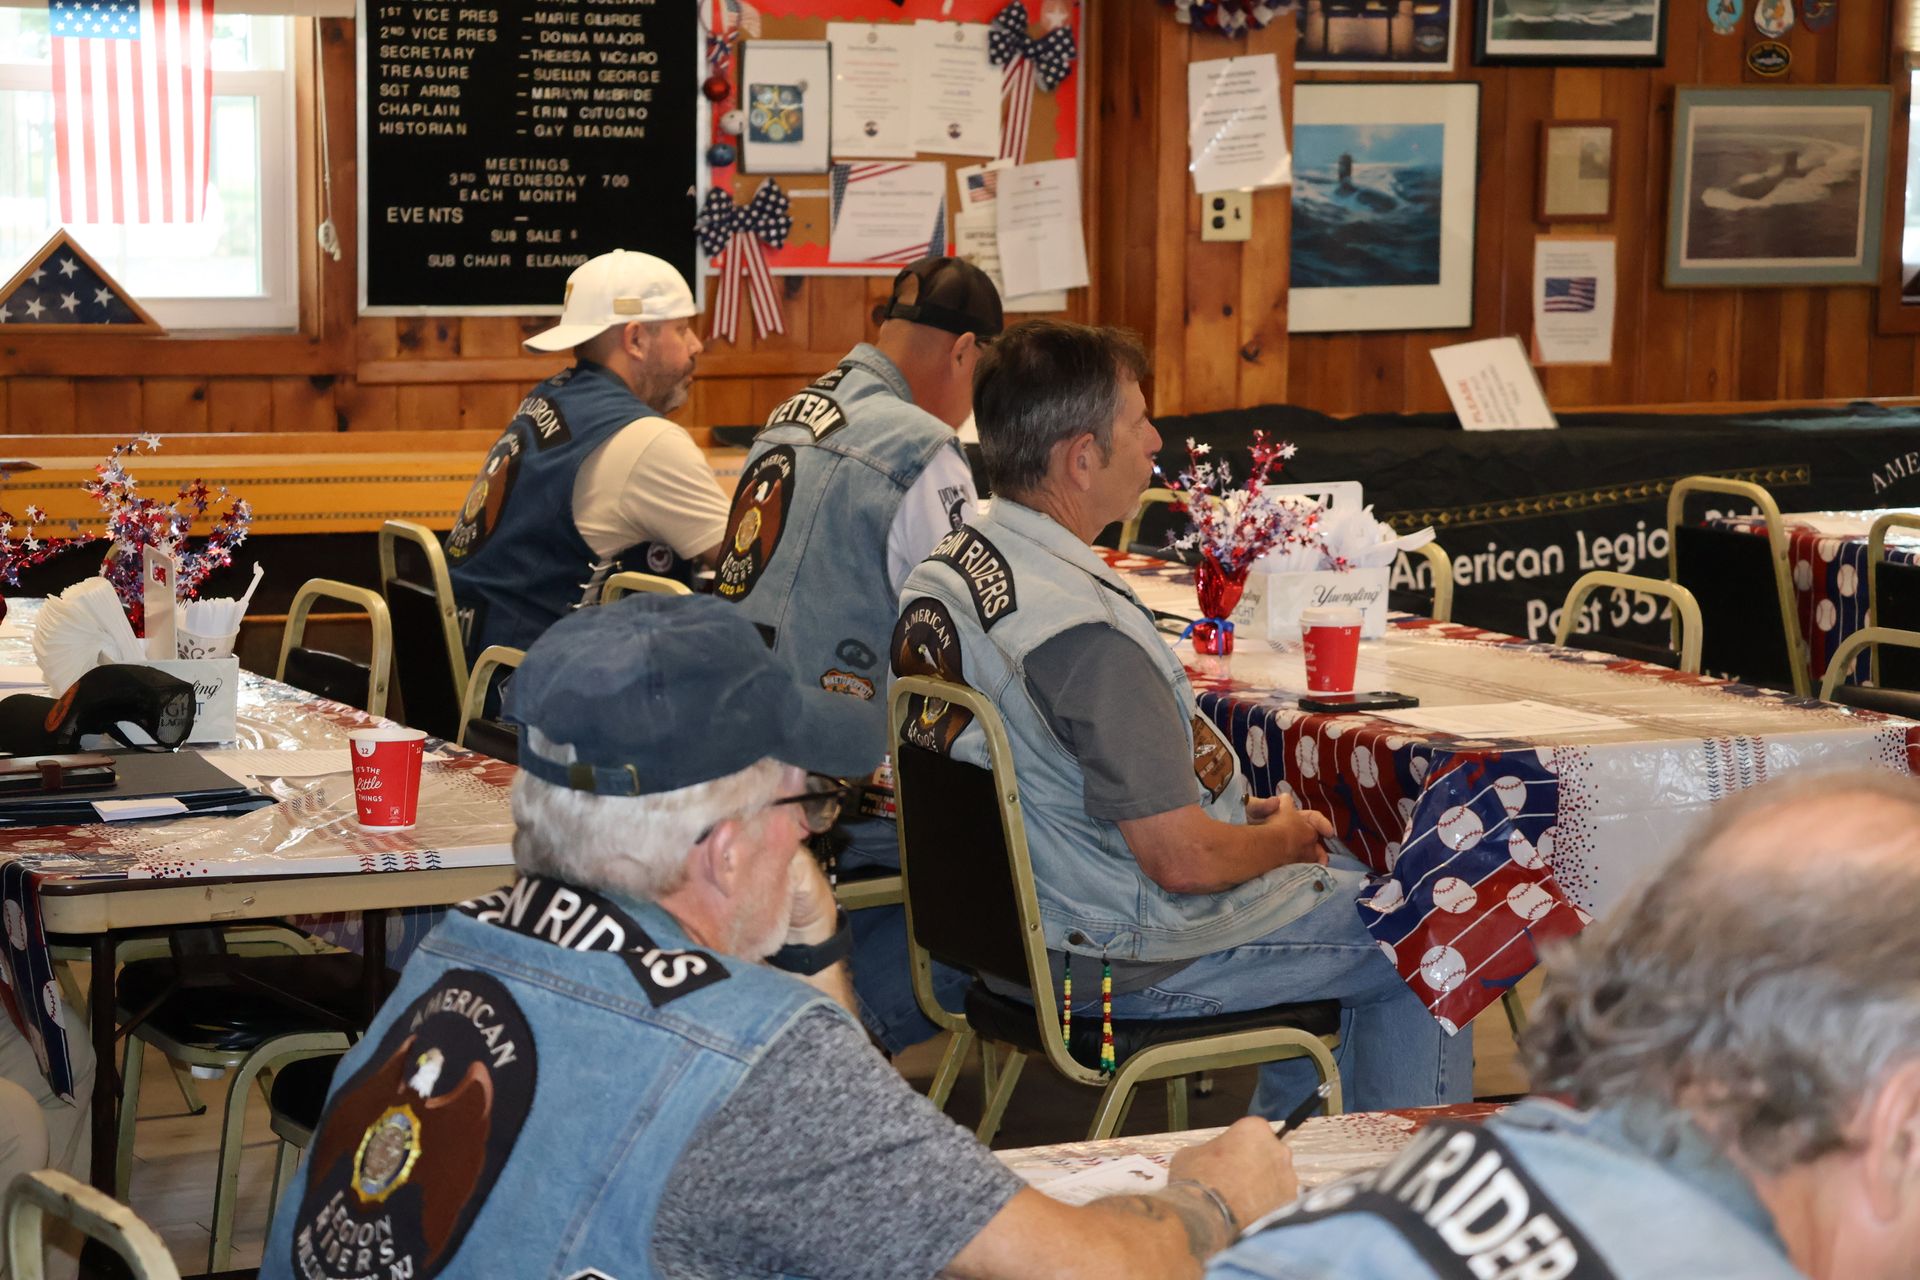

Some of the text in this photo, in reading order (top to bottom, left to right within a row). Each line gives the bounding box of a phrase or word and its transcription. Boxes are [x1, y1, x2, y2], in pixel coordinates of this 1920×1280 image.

[380, 7, 499, 23] 1ST VICE PRES
[534, 12, 580, 25] MARIE
[380, 26, 498, 42] 2ND VICE PRES
[540, 30, 646, 45] DONNA MAJOR
[380, 45, 475, 59] SECRETARY
[531, 49, 592, 62] THERESA
[380, 64, 470, 79] TREASURE
[597, 69, 661, 83] GEORGE
[380, 83, 461, 98] SGT ARMS
[378, 102, 460, 117] CHAPLAIN
[532, 105, 568, 118] ERIN
[379, 122, 468, 135] HISTORIAN
[534, 124, 564, 138] GAY
[485, 158, 570, 172] MEETINGS
[449, 172, 630, 188] 3RD WEDNESDAY 700
[459, 188, 577, 202] EACH MONTH
[386, 206, 464, 224] EVENTS
[490, 229, 518, 243] SUB
[526, 229, 562, 243] SALE
[428, 254, 456, 267] SUB
[463, 254, 511, 267] CHAIR
[1575, 520, 1670, 574] Legio
[958, 538, 1010, 619] RIDERS
[1311, 584, 1383, 608] Yuengling
[904, 608, 951, 650] AMERICAN
[361, 747, 369, 755] 12
[366, 767, 381, 775] THE
[358, 793, 383, 802] THINGS
[409, 988, 518, 1069] AMERICAN
